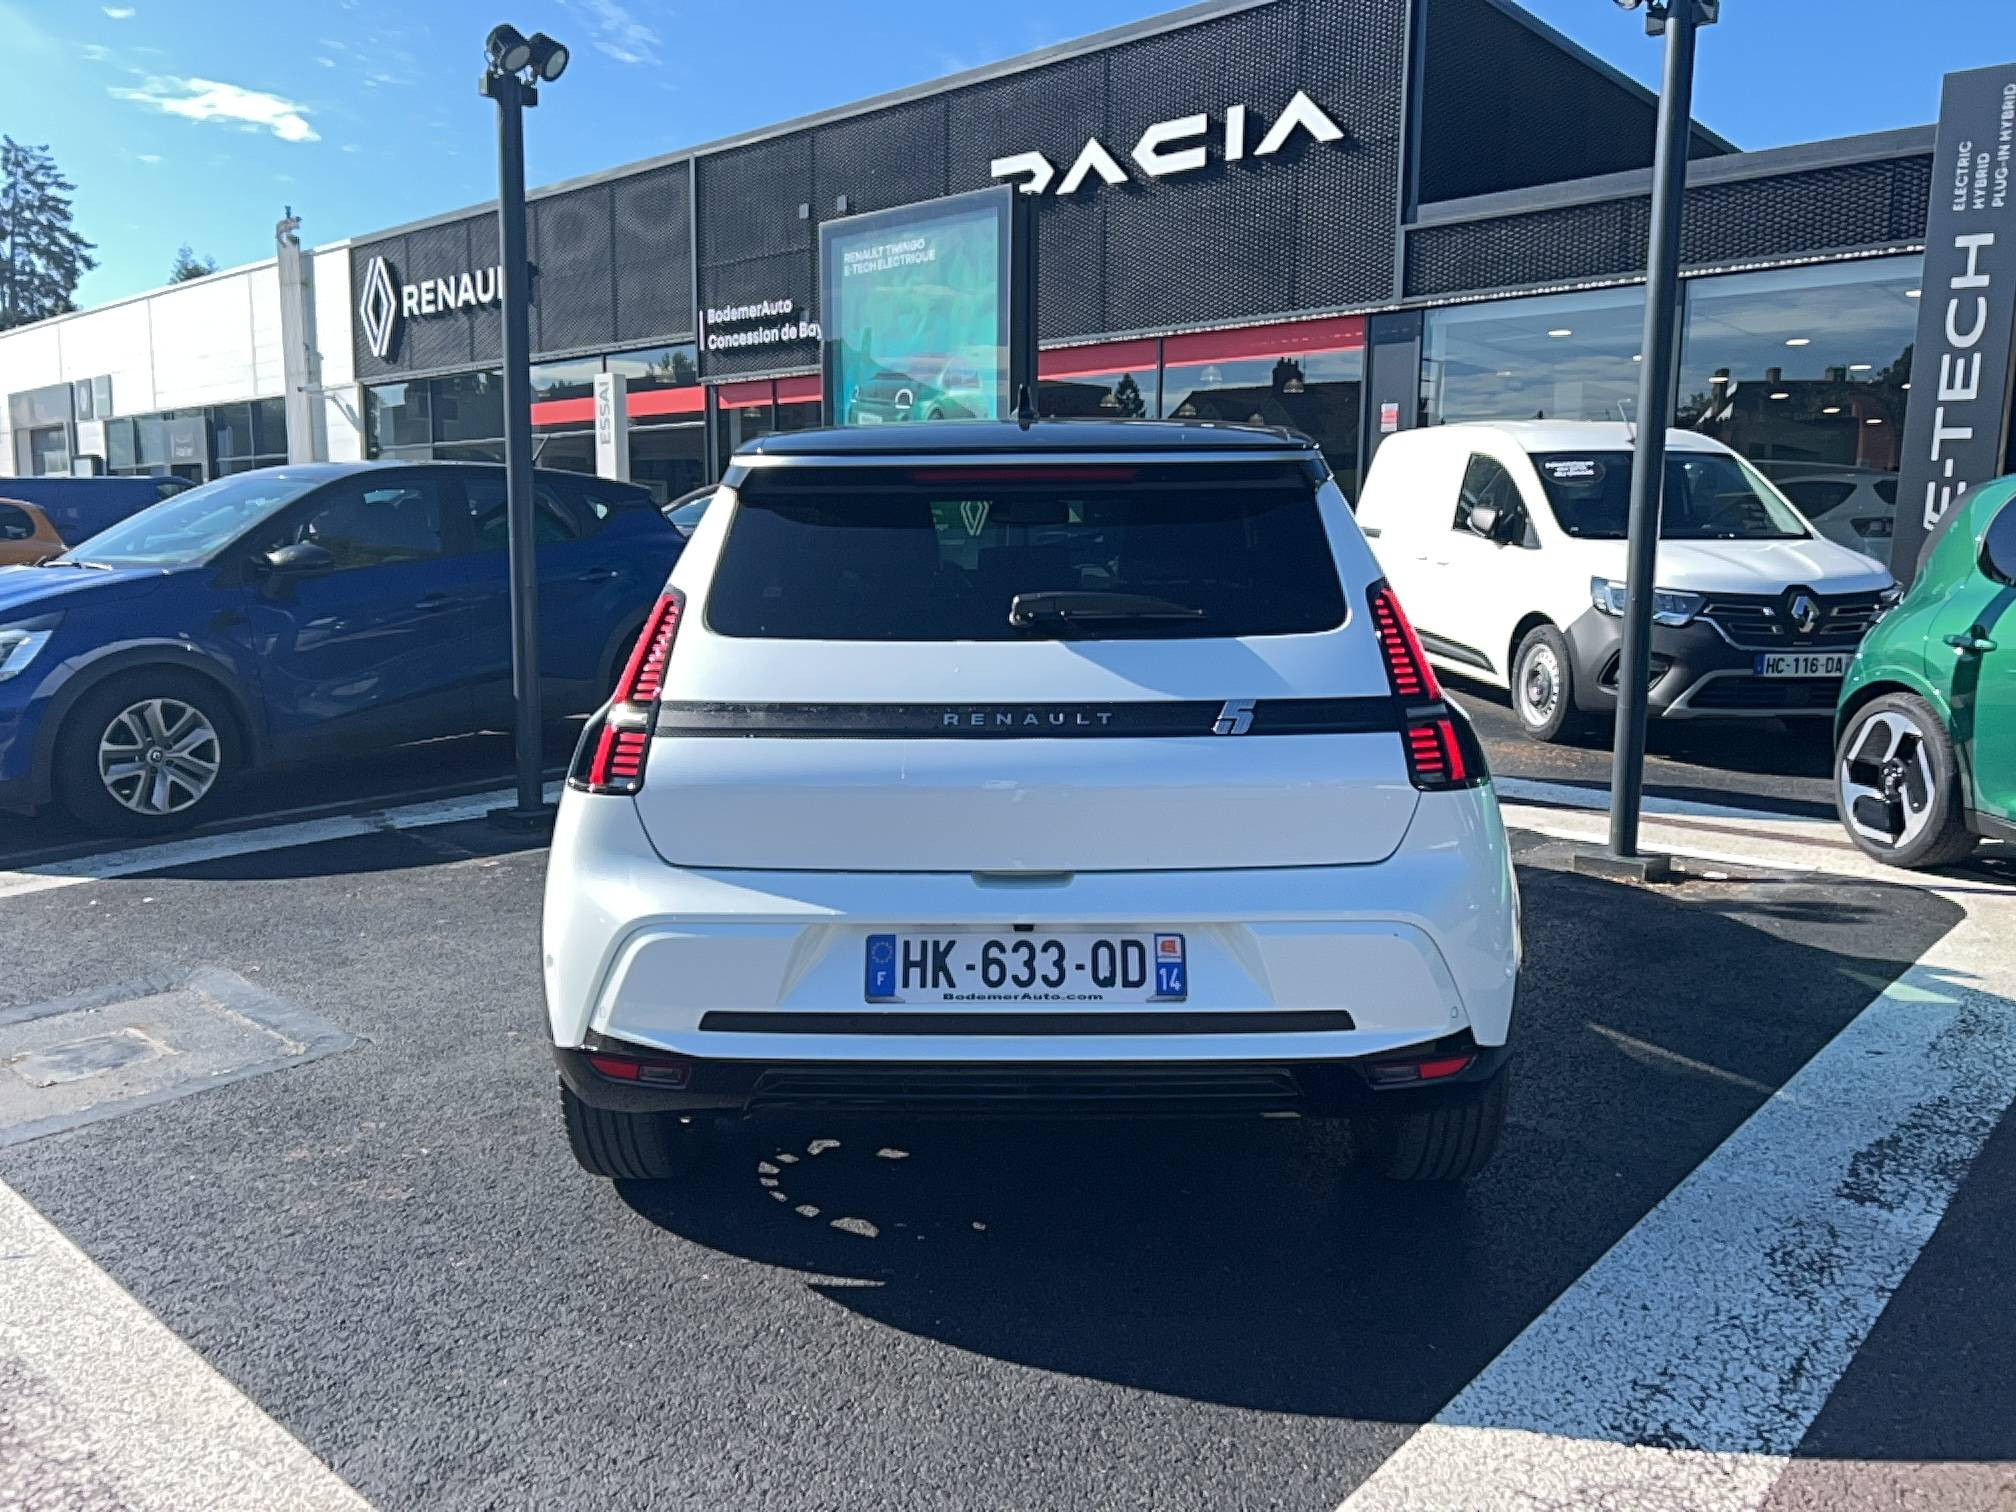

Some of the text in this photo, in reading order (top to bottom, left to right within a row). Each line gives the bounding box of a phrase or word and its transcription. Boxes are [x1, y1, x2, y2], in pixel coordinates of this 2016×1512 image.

[991, 90, 1345, 196] DACIA
[1991, 83, 2016, 208] PLUG-IN HYBRID
[1952, 140, 1972, 212] ELECTRIC
[1972, 152, 1990, 210] HYBRID
[844, 245, 884, 265] RENAULT
[706, 299, 793, 325] BodemerAuto
[708, 325, 779, 350] Concession
[780, 322, 798, 341] de
[1923, 232, 1995, 531] E-TECH
[599, 381, 612, 445] ESSAI
[1765, 656, 1844, 675] HC-116-DA
[942, 712, 1113, 726] RENAULT
[902, 939, 1147, 989] HK-633-QD
[876, 971, 887, 986] F
[1159, 967, 1182, 991] 14
[942, 991, 1104, 1002] BodemerAuto.com
